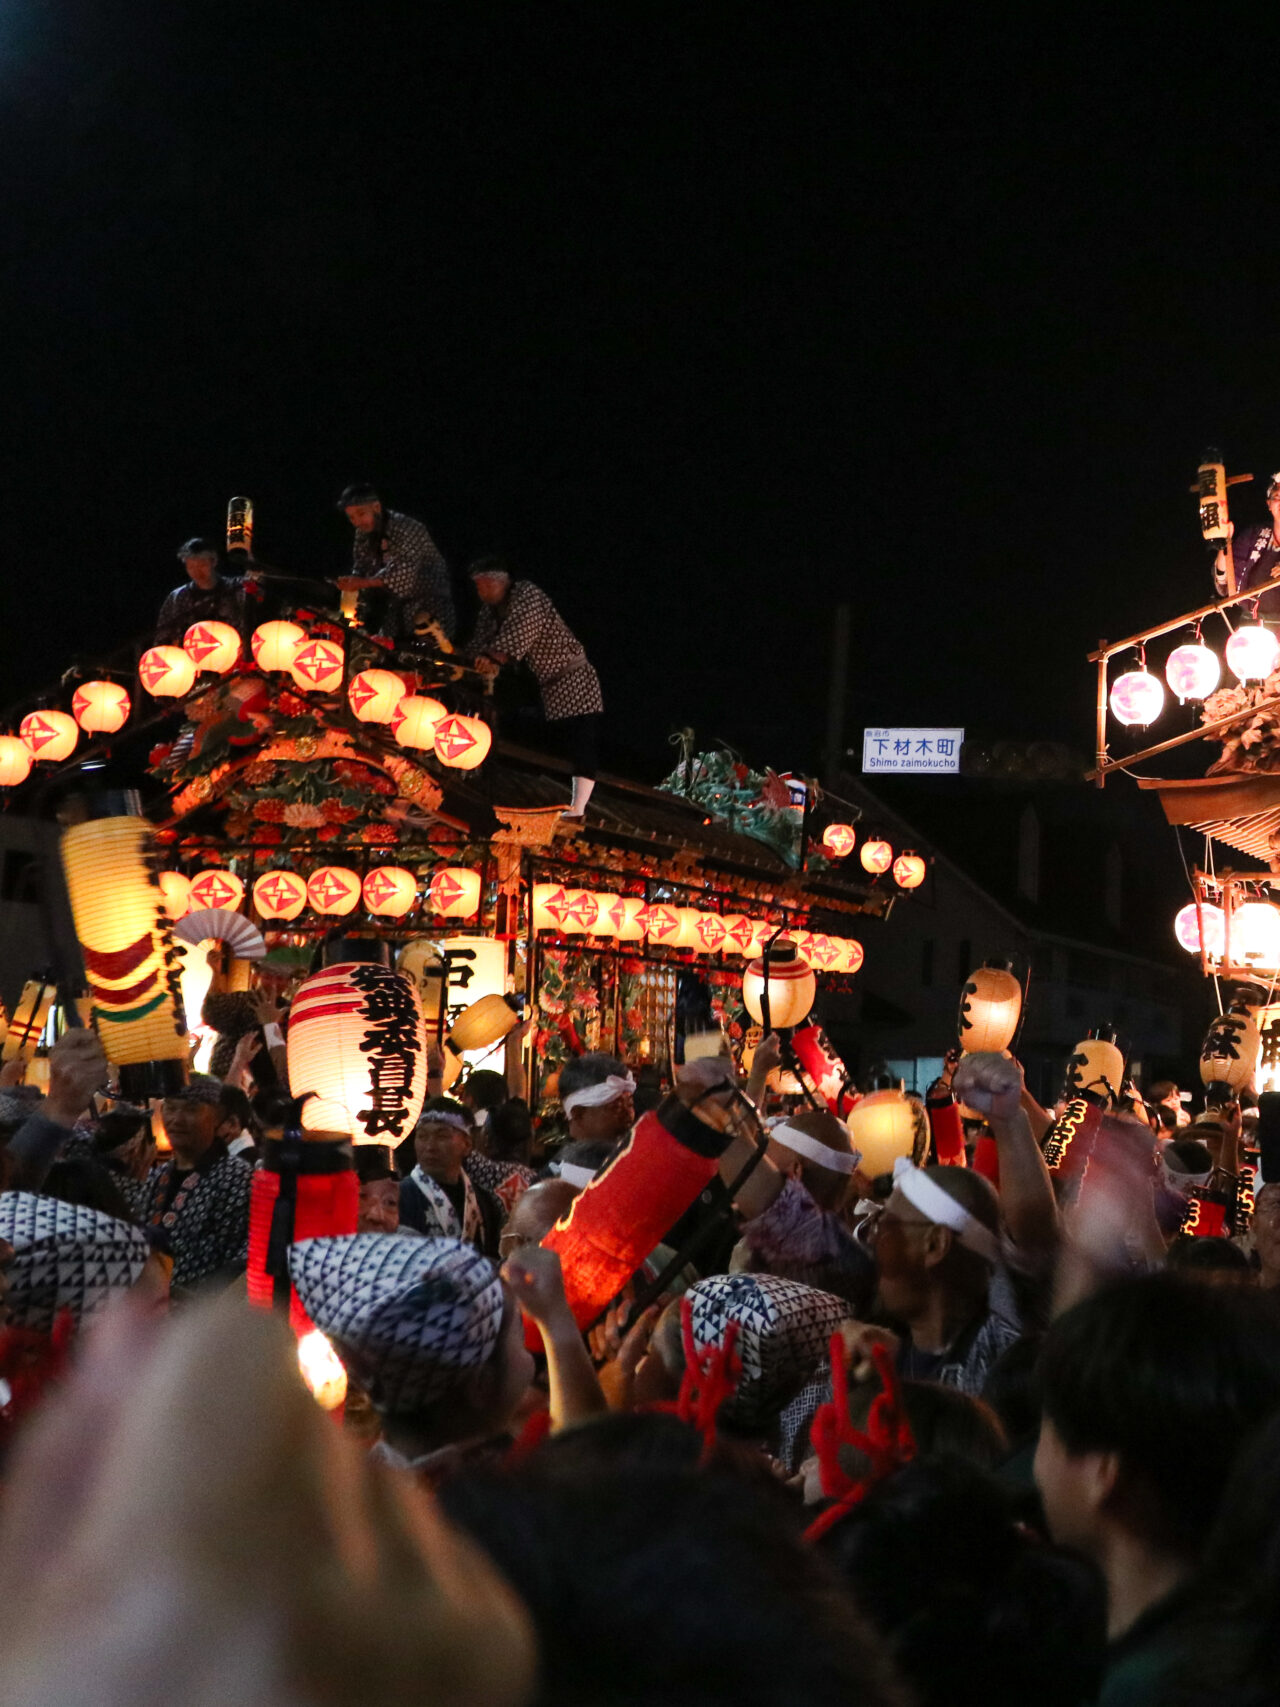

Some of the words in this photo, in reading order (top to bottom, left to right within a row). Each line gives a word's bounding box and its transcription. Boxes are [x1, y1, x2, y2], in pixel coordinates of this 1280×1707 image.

[872, 738, 955, 756] 下材木町
[870, 757, 898, 767] Shimo
[900, 757, 956, 768] zaimokucho
